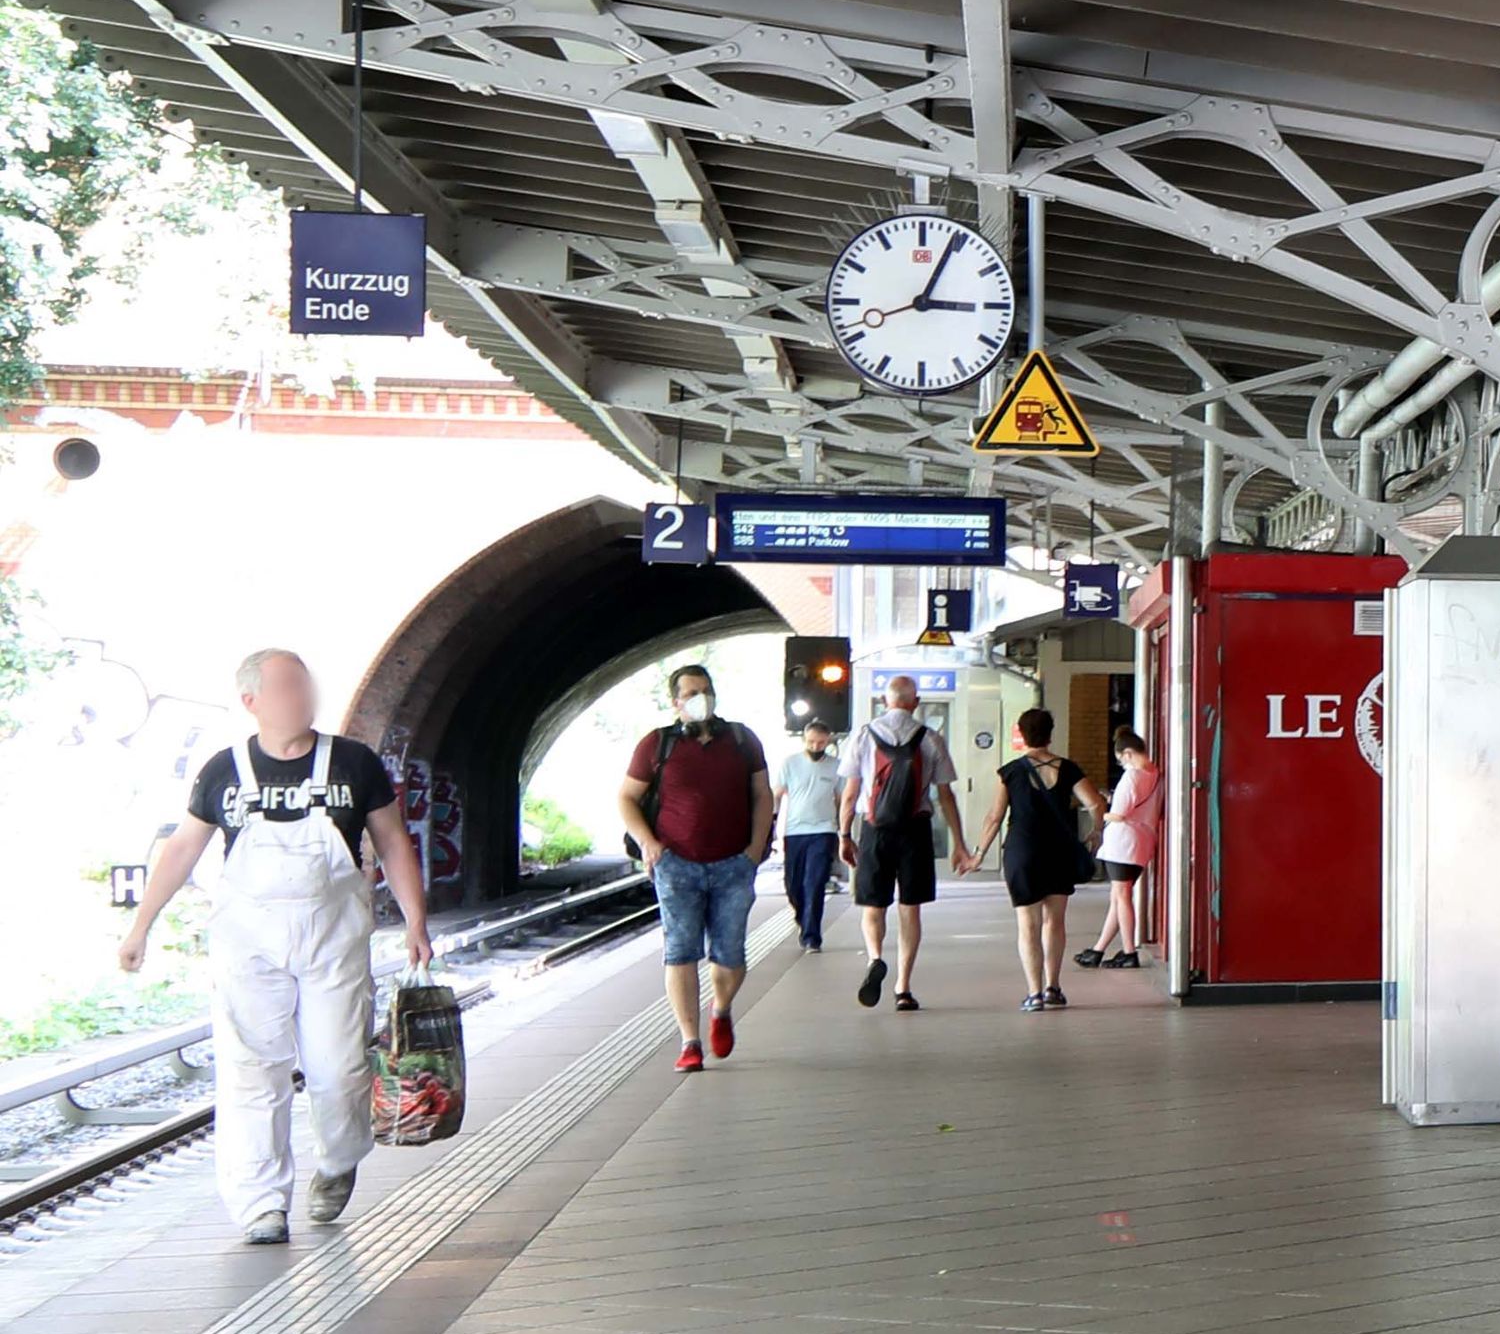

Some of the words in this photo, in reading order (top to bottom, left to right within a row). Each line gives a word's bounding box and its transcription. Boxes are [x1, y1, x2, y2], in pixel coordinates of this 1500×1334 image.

[305, 267, 410, 298] Kurzzug
[305, 298, 370, 322] Ende
[652, 505, 686, 550] 2
[733, 525, 755, 535] S42
[808, 537, 849, 547] Pankow
[1266, 695, 1344, 738] LE
[222, 784, 353, 810] CIFOIA
[113, 868, 144, 902] H
